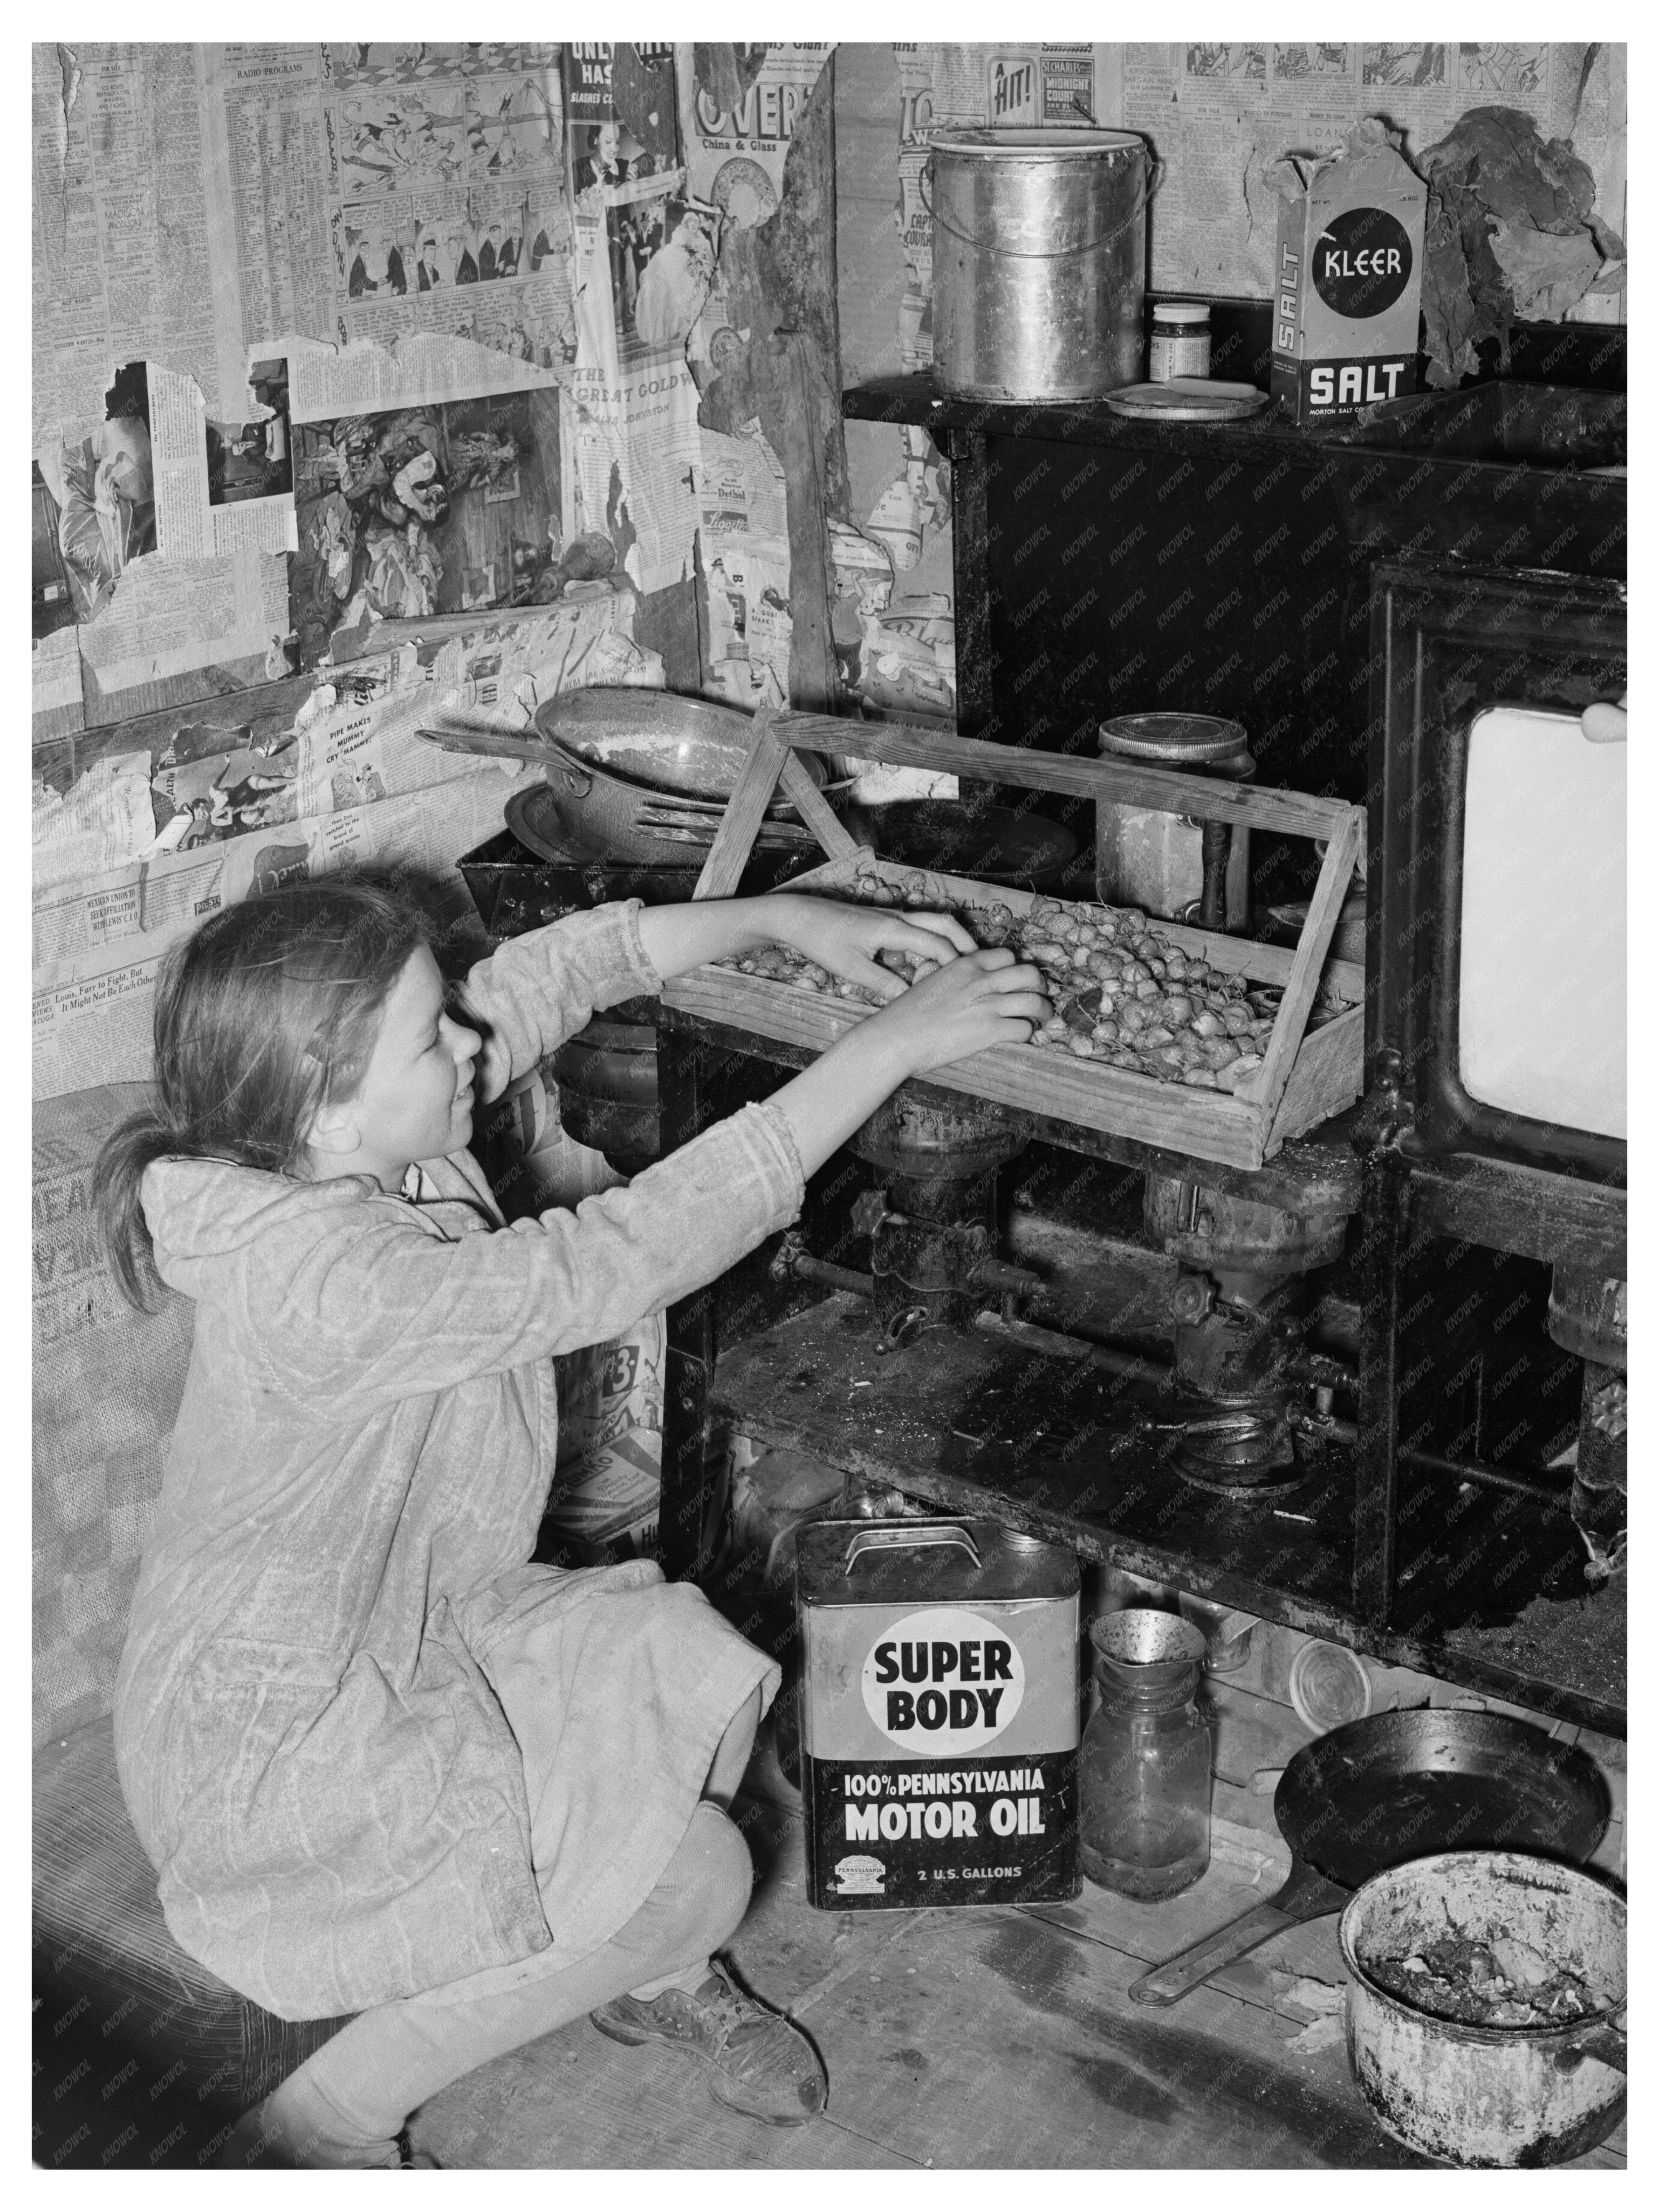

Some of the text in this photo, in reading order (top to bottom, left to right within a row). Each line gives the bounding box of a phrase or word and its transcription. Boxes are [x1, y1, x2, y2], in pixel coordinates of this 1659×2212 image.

[237, 64, 303, 79] RADIO PROGRAMS
[995, 62, 1005, 79] A
[1125, 76, 1154, 84] BARGAIN
[1129, 67, 1173, 77] KIRSCHMAN'S
[994, 64, 1031, 116] HIT!
[1046, 77, 1090, 90] MIDNIGHT
[570, 91, 601, 103] SLASHES
[702, 138, 777, 152] China & Glass
[105, 207, 143, 220] MADISON
[333, 231, 345, 278] DUNN
[1325, 248, 1402, 277] KLEER
[1278, 241, 1299, 351] SALT
[574, 367, 605, 382] THE
[1310, 363, 1405, 405] SALT
[576, 387, 634, 403] GREAT
[624, 403, 670, 424] JOHNSTON
[330, 716, 371, 740] PIPE MAKES
[337, 730, 365, 748] MUMMY
[326, 735, 372, 764] CRY MAMMY!
[121, 786, 133, 828] Remember
[326, 823, 344, 836] switched
[333, 830, 348, 840] brand
[330, 834, 361, 851] grand aroma
[87, 889, 136, 909] MEXICAN UNION TO
[90, 900, 136, 920] SEEK AFFILIATION
[92, 921, 104, 932] WITH
[55, 968, 143, 1004] Louis, Farr to Fight, But
[62, 1003, 69, 1013] It
[70, 997, 91, 1011] Might
[92, 990, 106, 1002] Not
[107, 986, 118, 996] Be
[118, 980, 136, 993] Each
[874, 1640, 1014, 1684] SUPER
[886, 1687, 1005, 1731] BODY
[844, 1768, 1045, 1796] 100% PENNSYLVANIA
[844, 1797, 1045, 1841] MOTOR OIL
[917, 1866, 1022, 1881] 2 U.S. GALLONS
